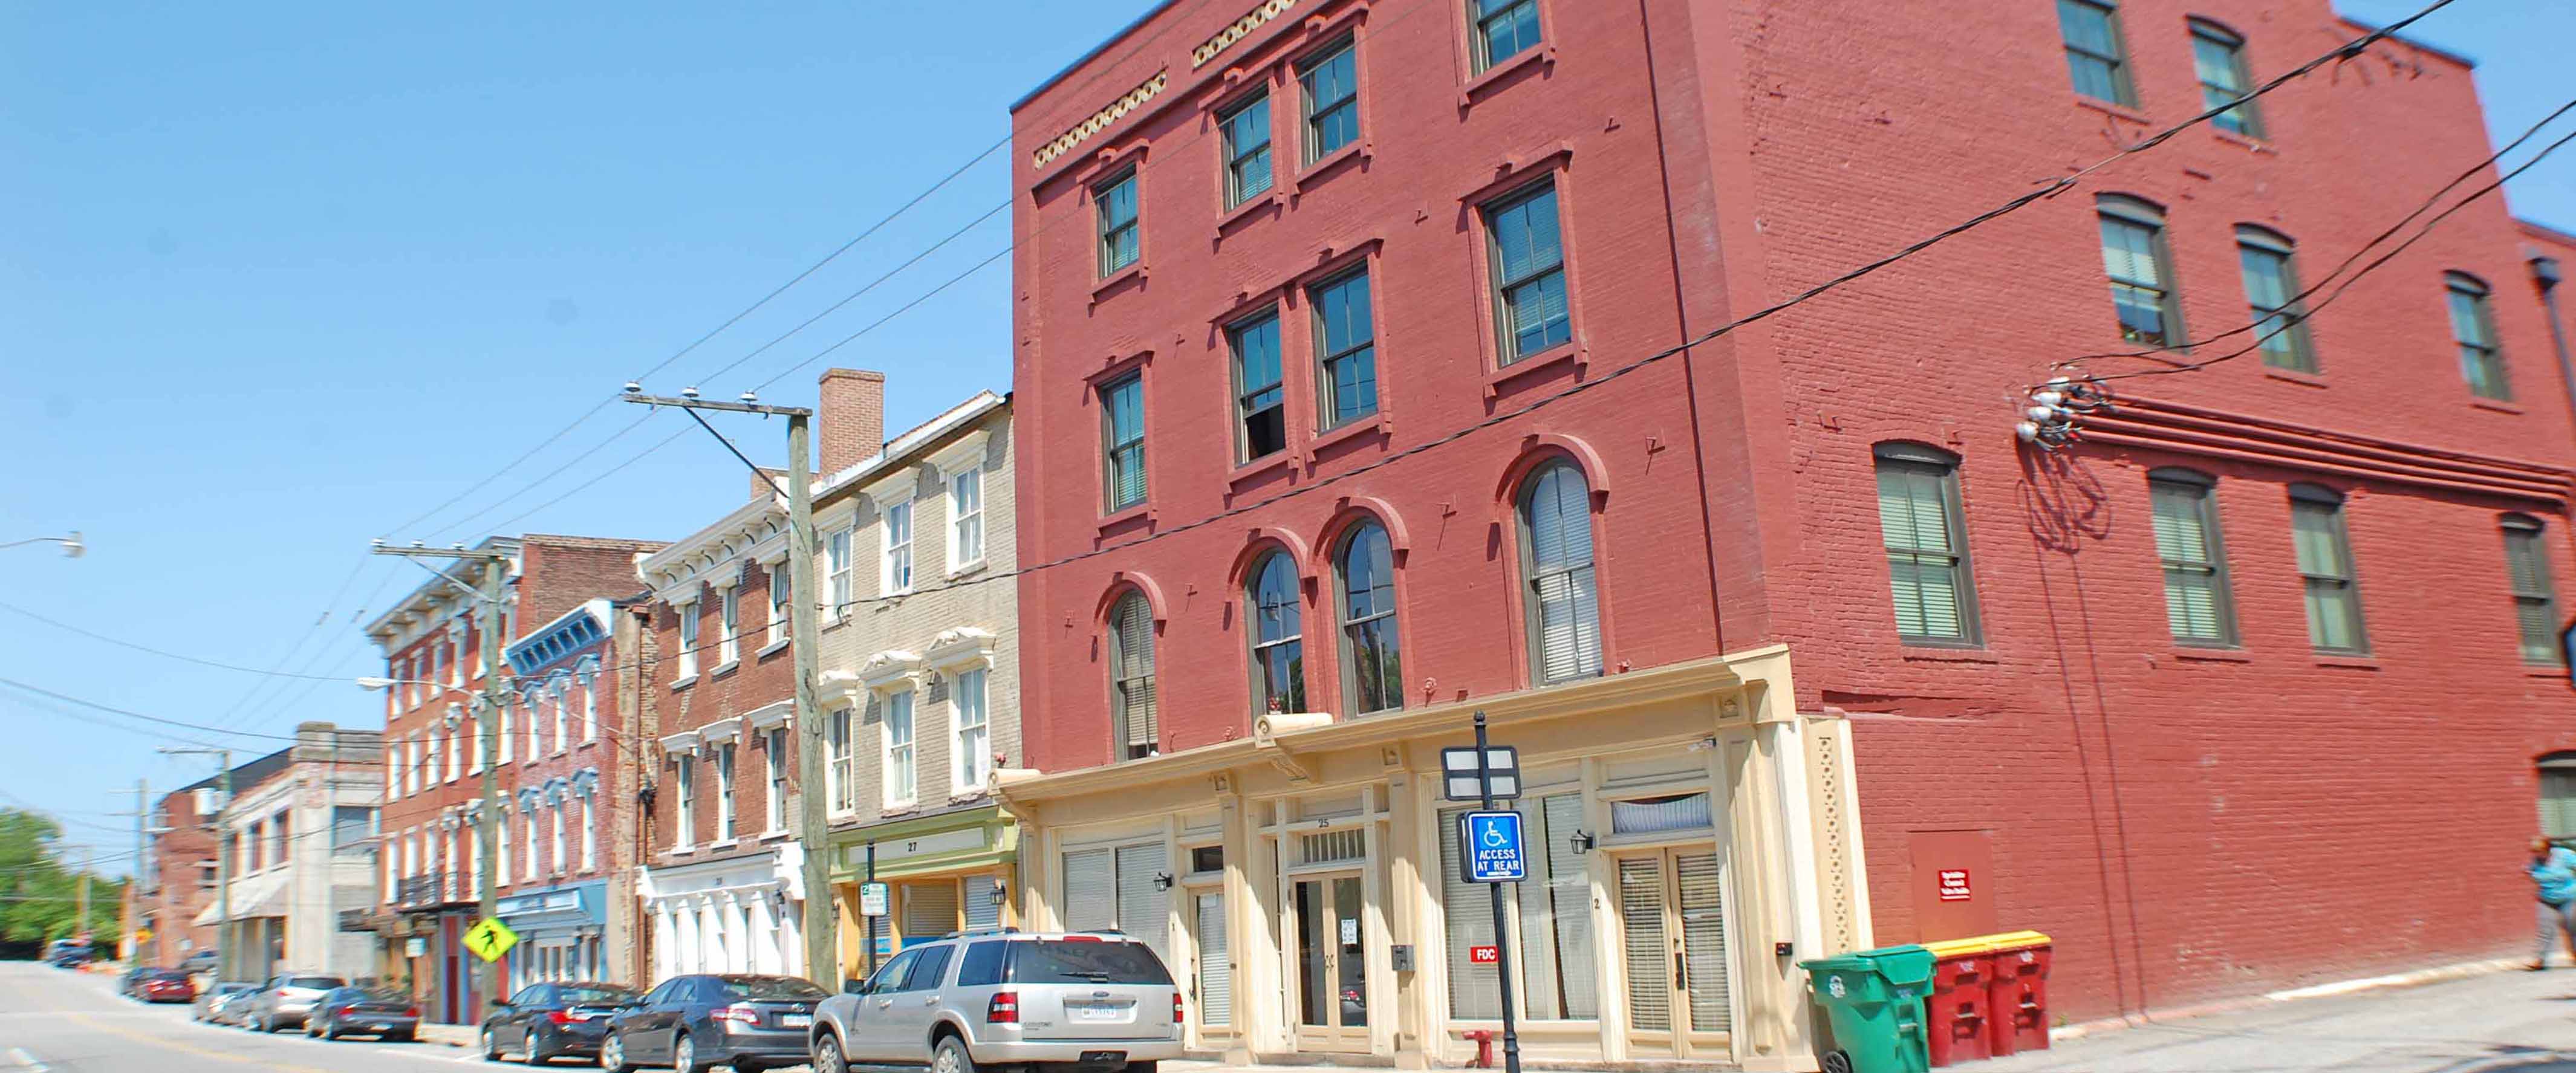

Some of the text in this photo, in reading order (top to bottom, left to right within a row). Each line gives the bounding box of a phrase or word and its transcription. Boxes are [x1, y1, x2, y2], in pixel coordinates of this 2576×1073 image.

[1318, 818, 1329, 828] 25
[908, 842, 917, 852] 27
[1480, 849, 1516, 860] ACCESS
[1477, 860, 1520, 872] AT REAR
[1594, 898, 1600, 909] 2
[1477, 948, 1495, 960] FDC
